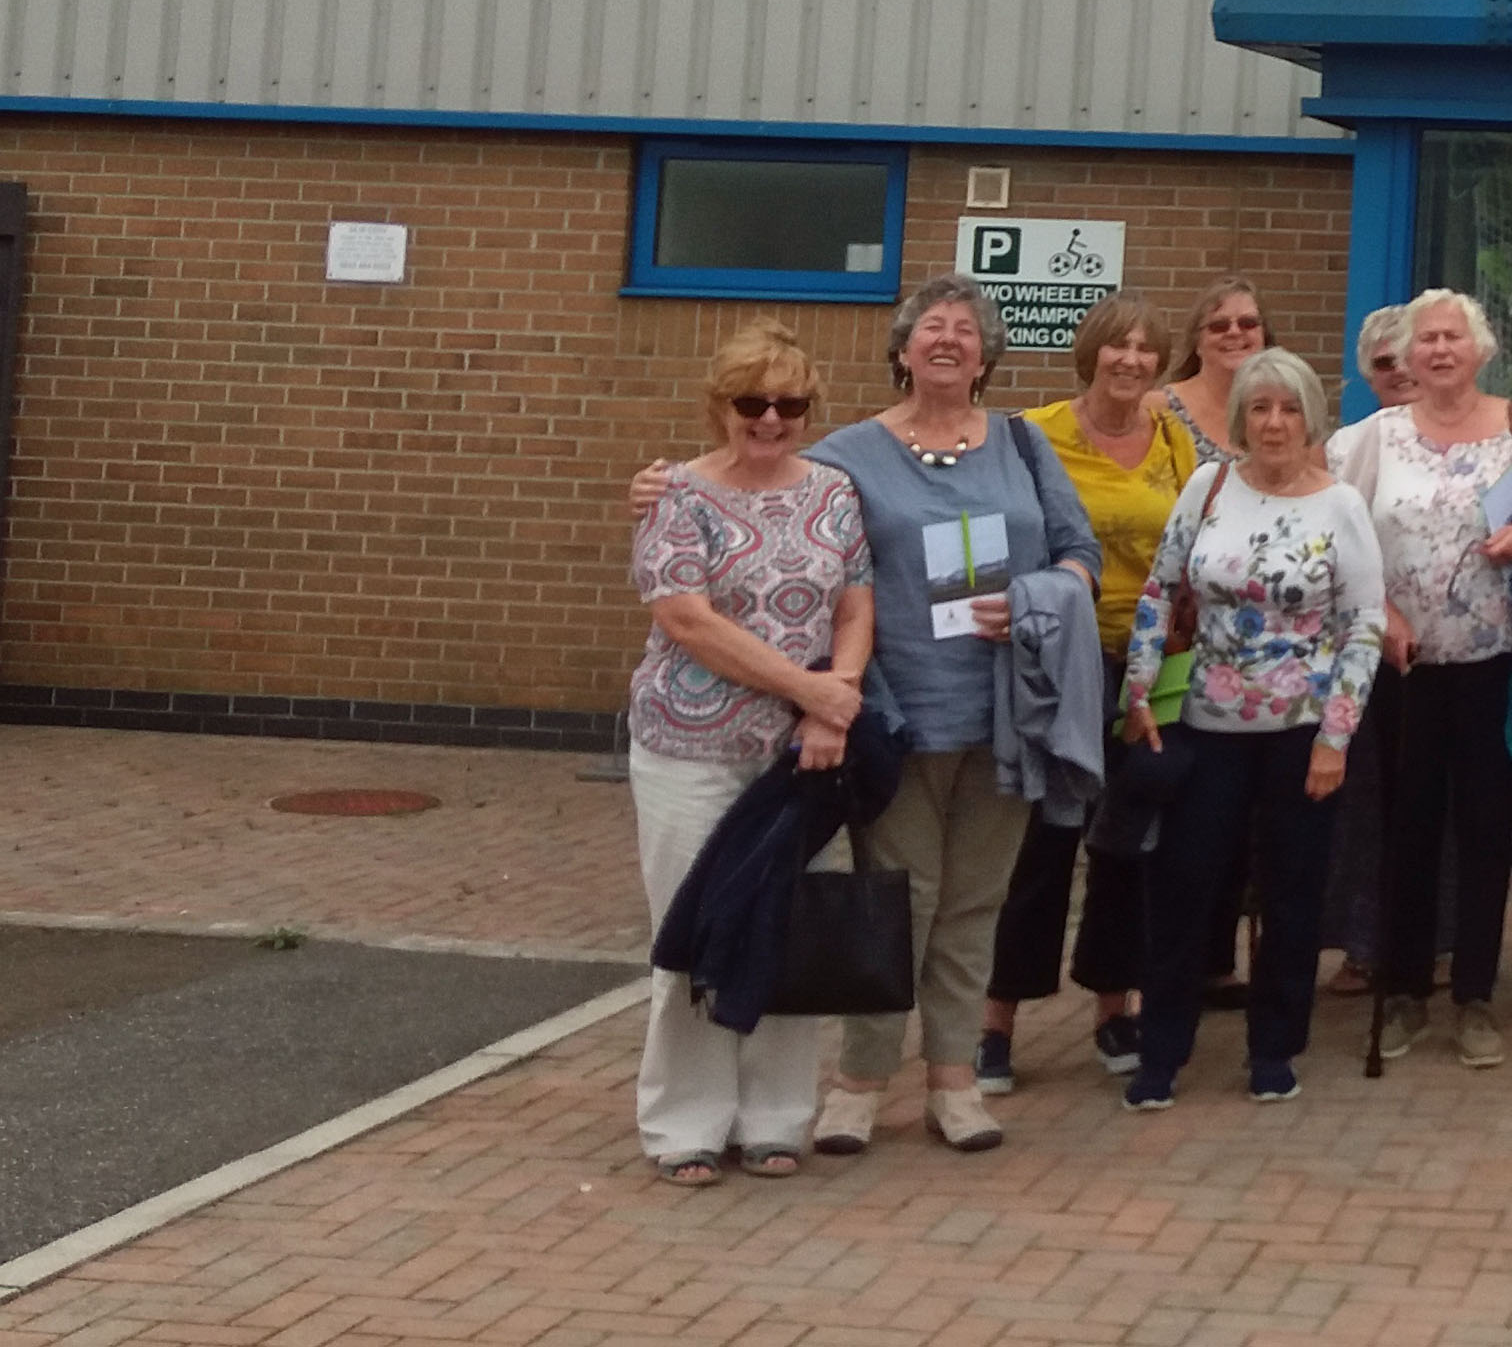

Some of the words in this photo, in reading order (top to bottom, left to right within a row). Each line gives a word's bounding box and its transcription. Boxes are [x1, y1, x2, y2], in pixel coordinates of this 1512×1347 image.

[980, 230, 1013, 271] P
[981, 284, 1013, 302] WO
[1014, 285, 1107, 303] WHEELED
[1001, 305, 1088, 325] CHAMPIO
[1005, 326, 1050, 345] KING
